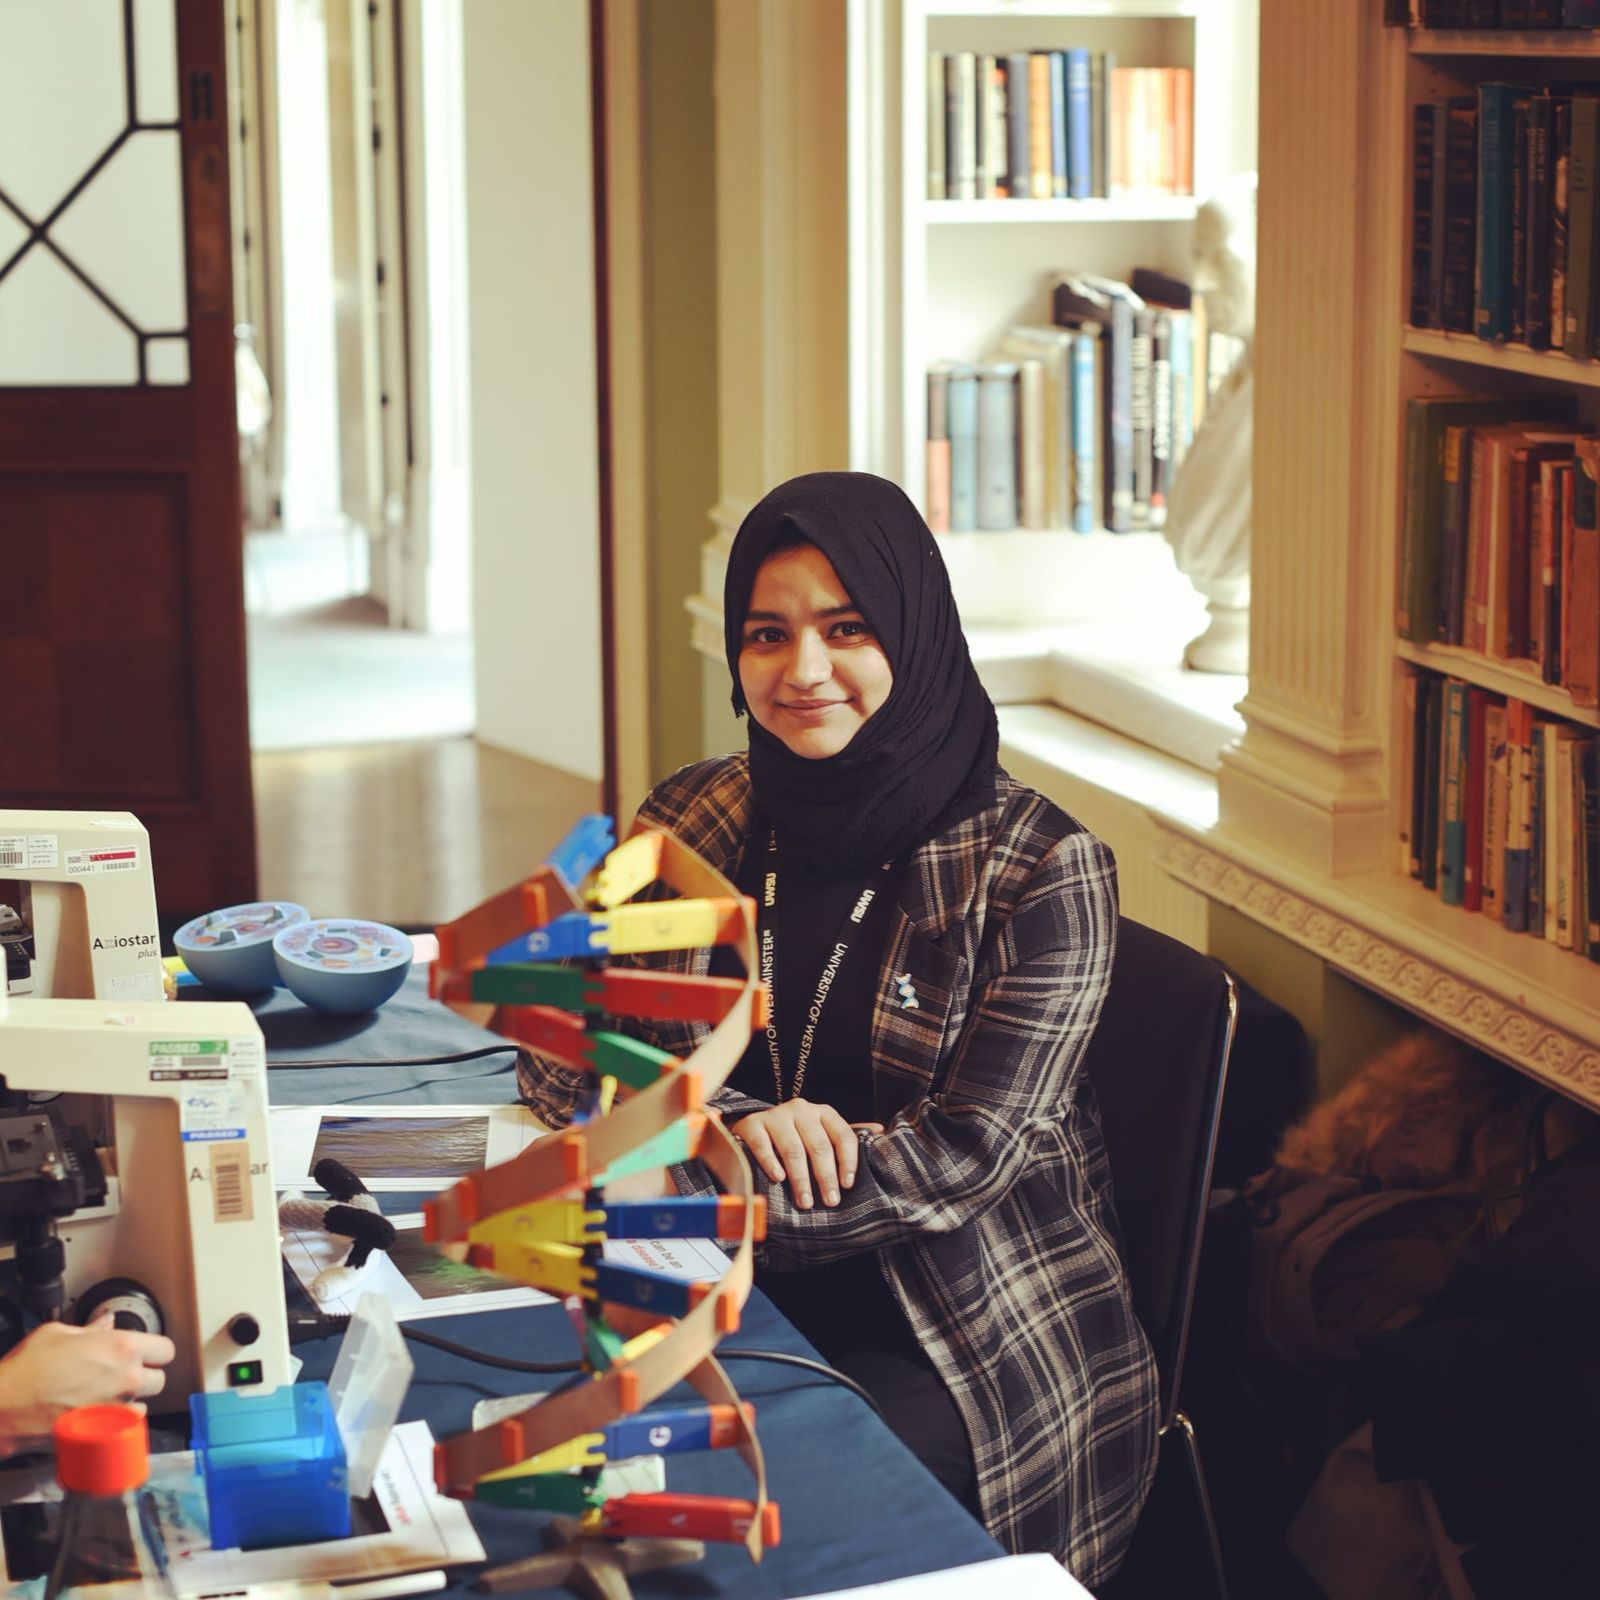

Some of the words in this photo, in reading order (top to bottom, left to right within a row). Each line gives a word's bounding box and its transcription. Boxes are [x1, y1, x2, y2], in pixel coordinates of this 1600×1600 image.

[67, 865, 96, 874] 000441
[764, 872, 777, 907] UWSU
[850, 888, 876, 923] UWSU
[93, 933, 156, 950] Axiostar
[137, 948, 157, 960] plus
[812, 942, 848, 1008] UNIVERSITY
[808, 1005, 821, 1025] OF
[765, 1022, 777, 1039] OF
[650, 1240, 666, 1252] can
[660, 1252, 675, 1260] be
[668, 1261, 683, 1269] an
